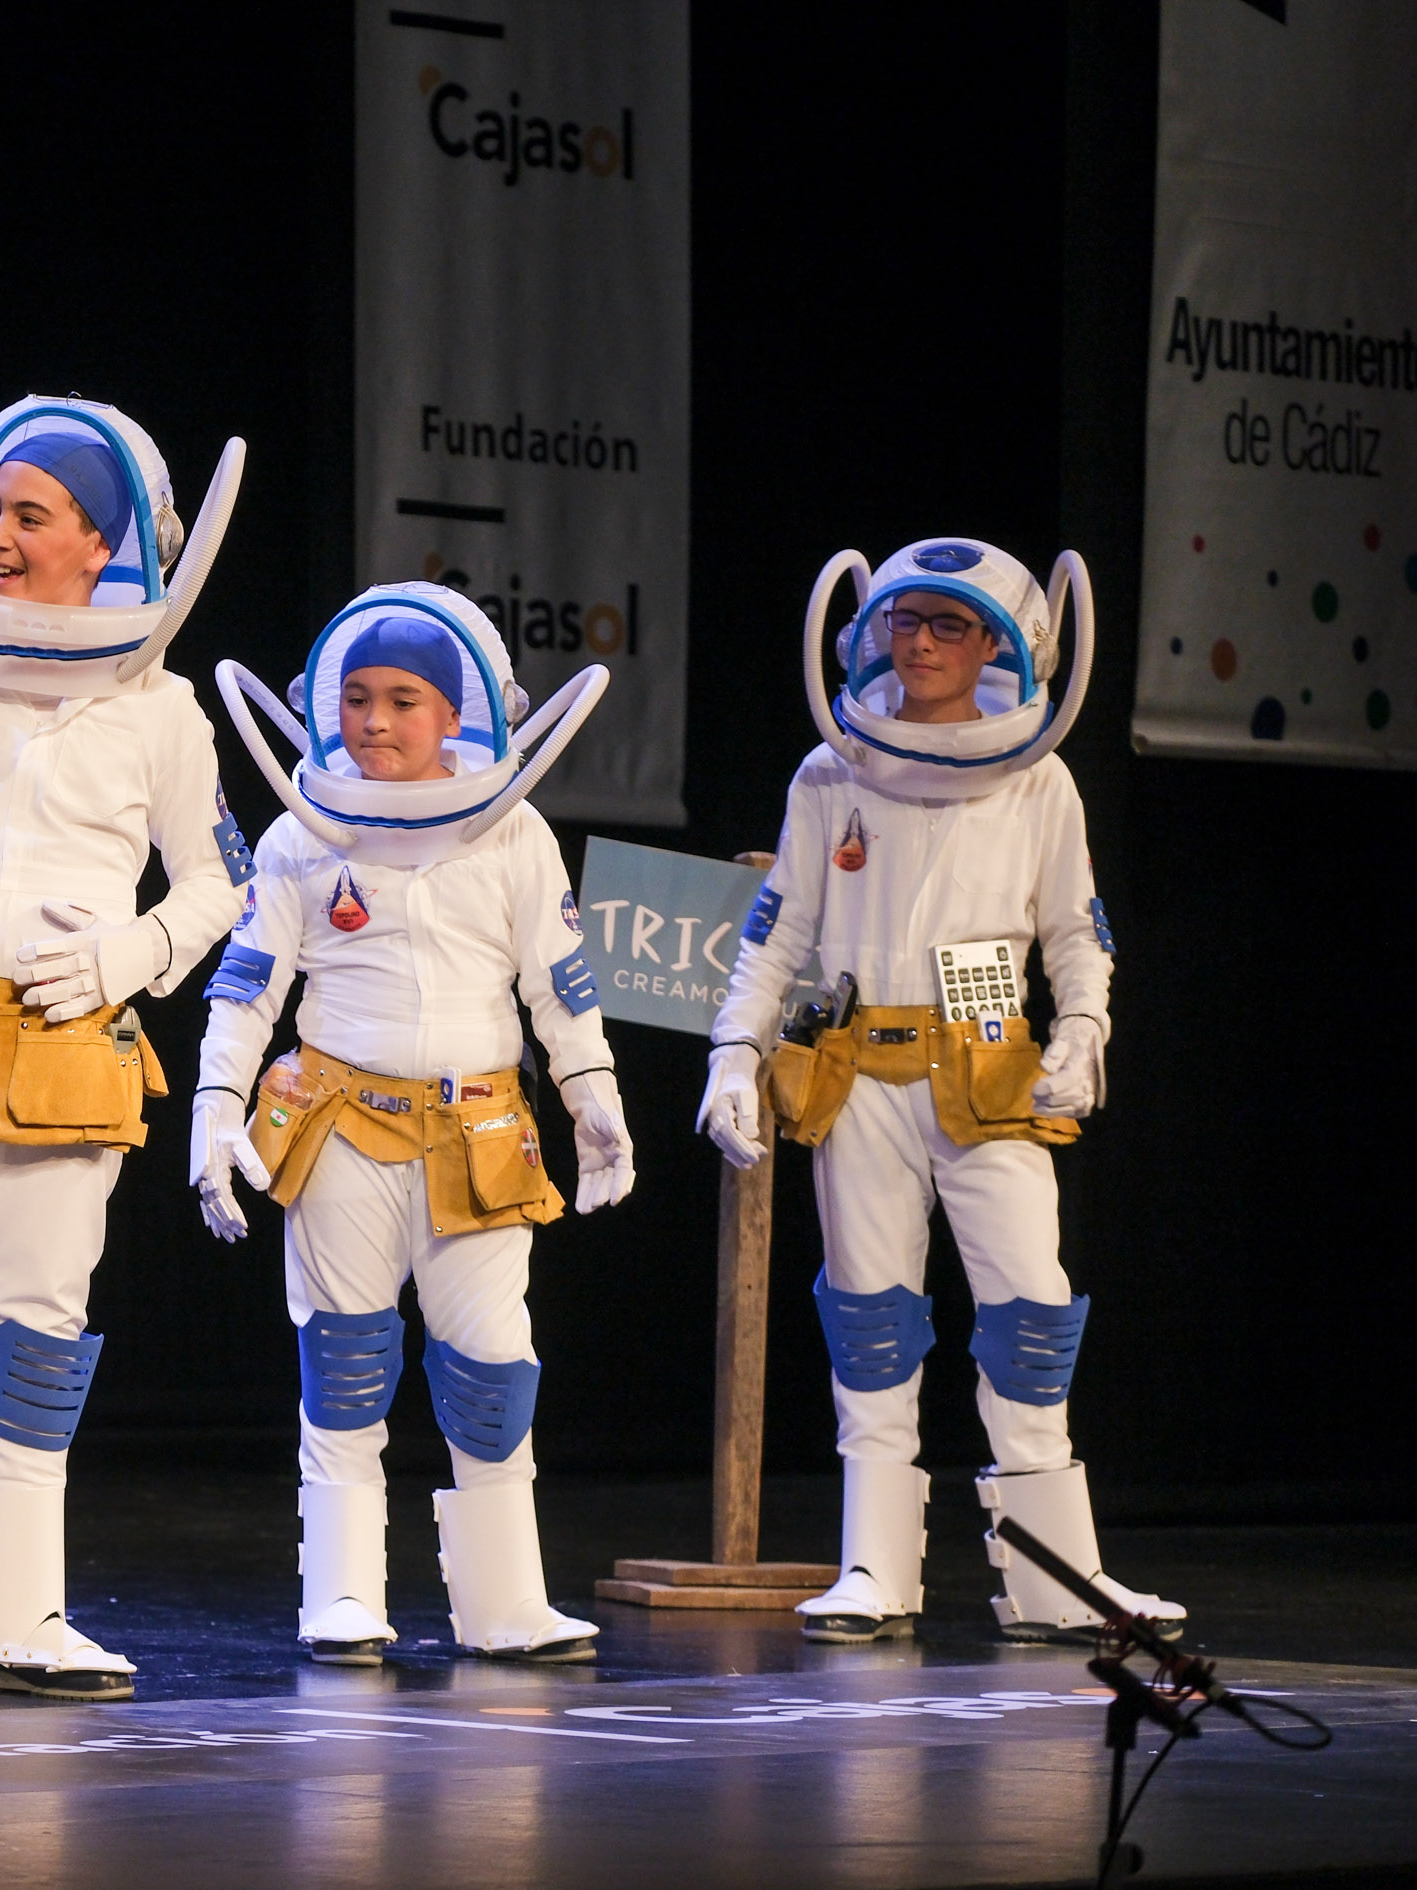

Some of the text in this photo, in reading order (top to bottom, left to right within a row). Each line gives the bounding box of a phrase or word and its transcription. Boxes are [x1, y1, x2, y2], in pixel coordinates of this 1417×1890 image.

[427, 82, 635, 187] Cajasol
[1166, 297, 1417, 392] Ayuntamient
[421, 405, 638, 472] Fundación
[1225, 399, 1382, 478] de Cádiz
